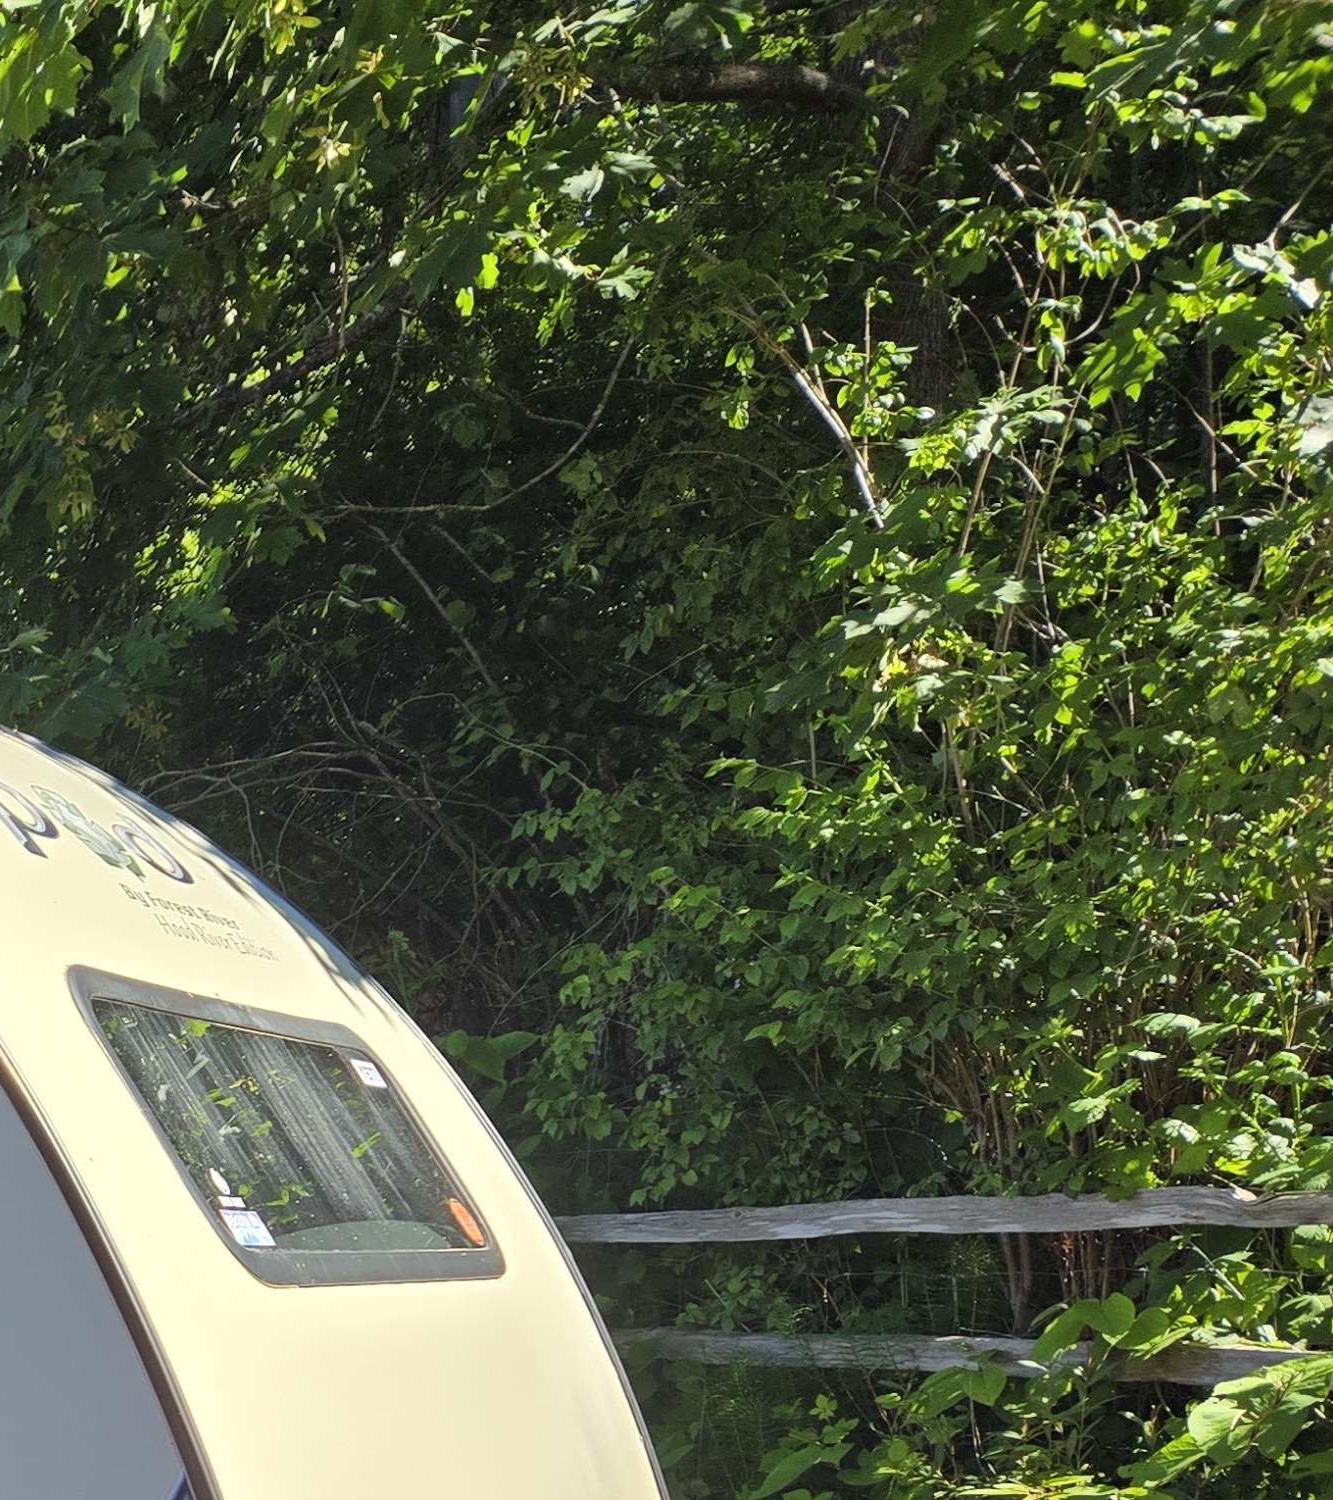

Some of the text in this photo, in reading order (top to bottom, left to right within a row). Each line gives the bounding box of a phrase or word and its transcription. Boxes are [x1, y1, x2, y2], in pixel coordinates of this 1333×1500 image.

[118, 882, 240, 930] By Forest River
[153, 912, 200, 942] Hood
[190, 922, 234, 951] River
